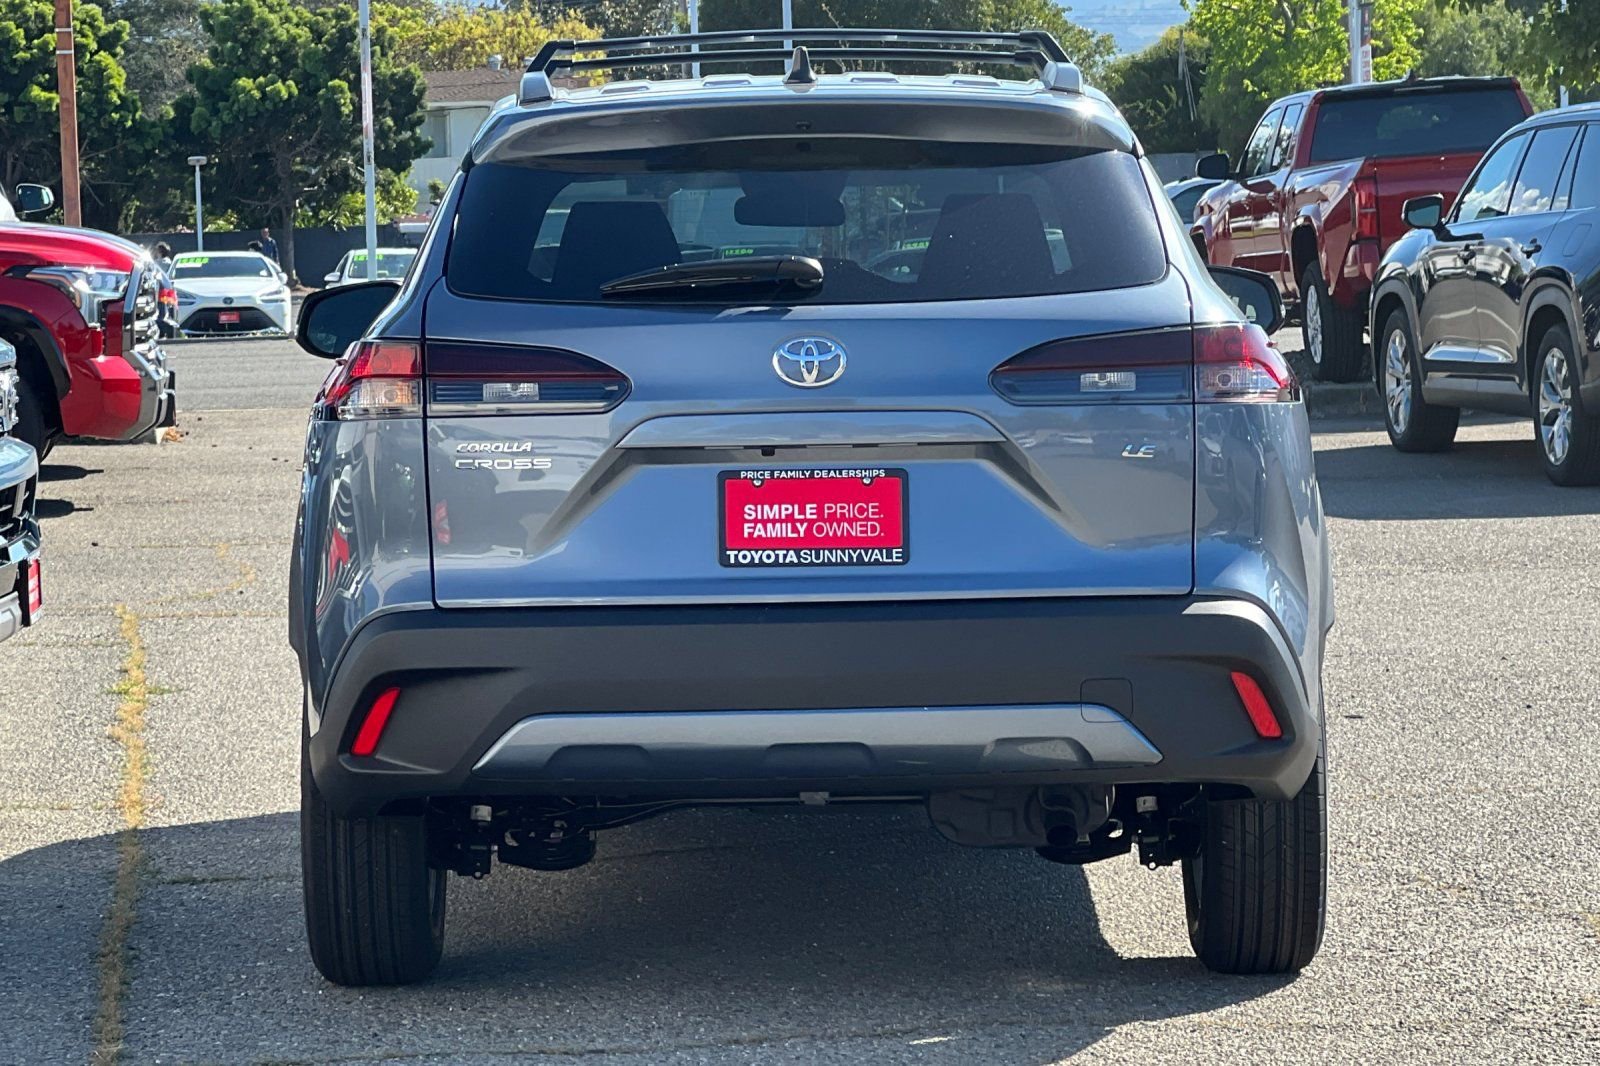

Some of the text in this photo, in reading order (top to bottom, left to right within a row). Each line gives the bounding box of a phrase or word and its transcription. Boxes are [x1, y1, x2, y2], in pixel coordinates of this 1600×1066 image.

[456, 442, 532, 453] COROLLA
[1121, 444, 1157, 458] LE
[455, 458, 552, 470] CROSS
[740, 469, 886, 479] PRICE FAMILY DEALERSHIPS
[743, 502, 884, 520] SIMPLE PRICE.
[743, 521, 885, 538] FAMILY OWNED.
[726, 548, 903, 564] TOYOTA SUNNYVALE
